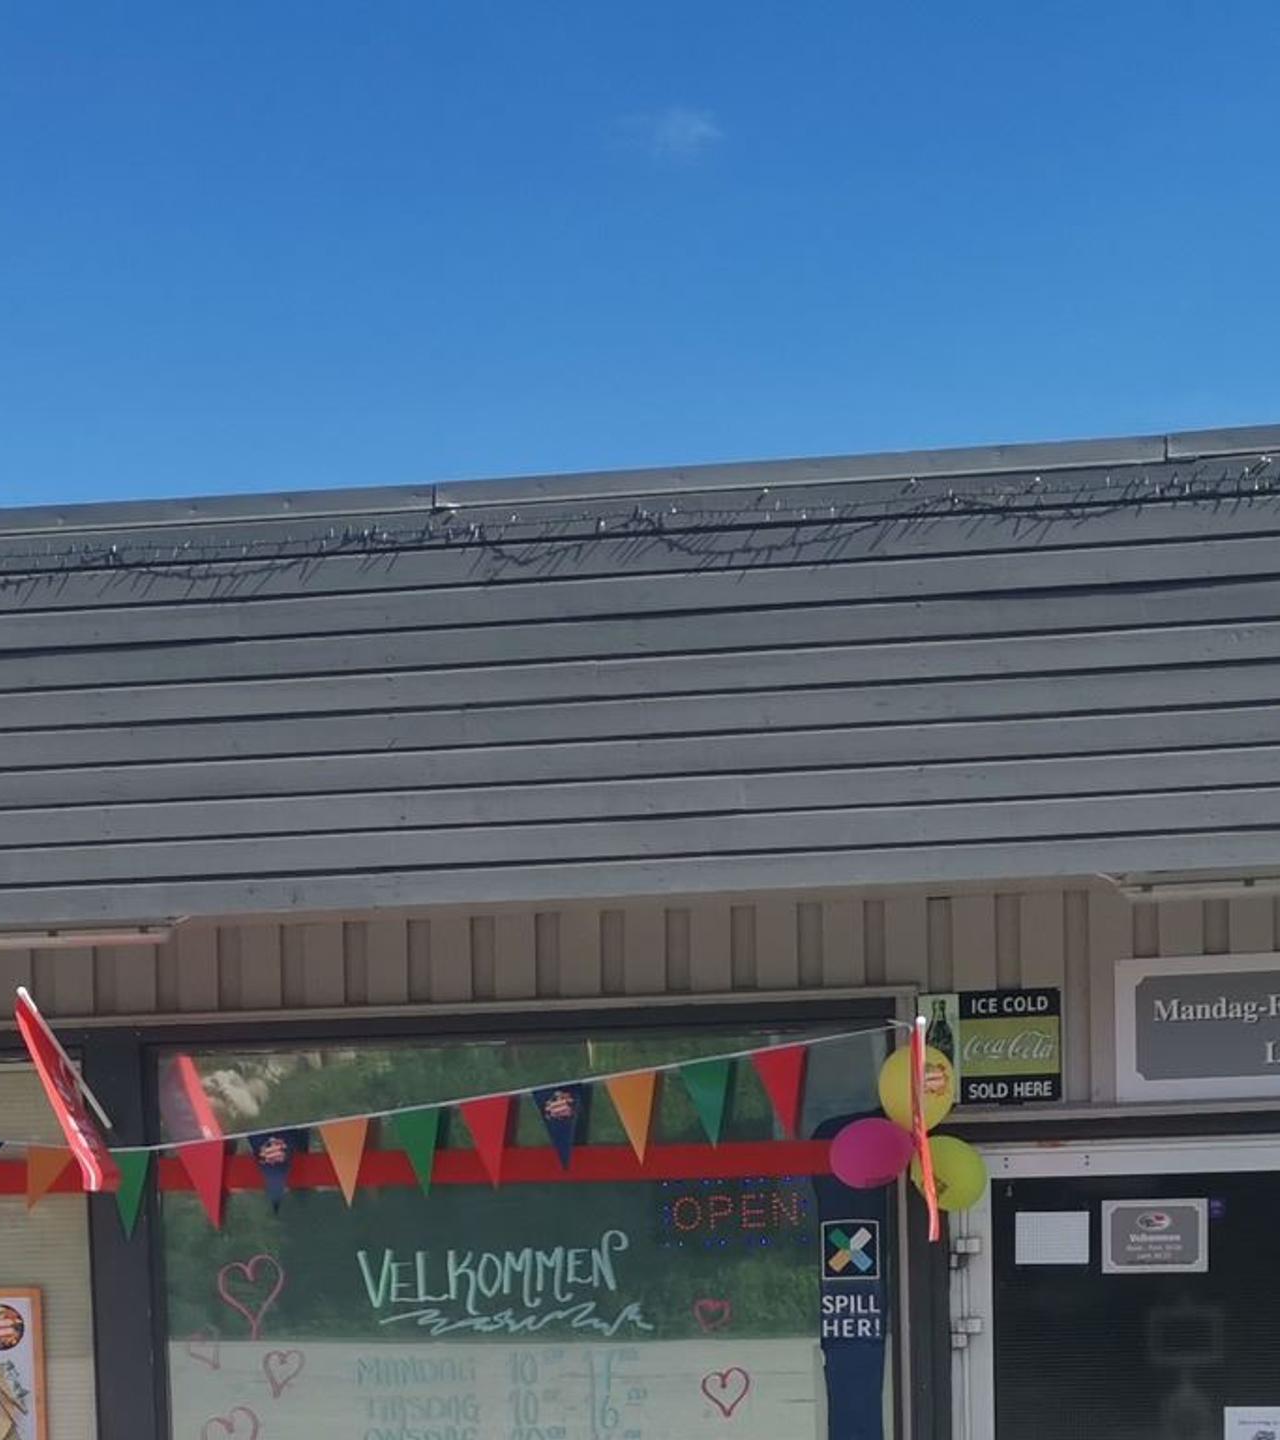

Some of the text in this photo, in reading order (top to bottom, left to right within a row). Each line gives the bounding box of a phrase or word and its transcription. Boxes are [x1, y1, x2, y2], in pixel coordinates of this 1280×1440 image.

[971, 996, 1048, 1014] ICE COLD
[968, 1081, 1053, 1099] SOLD HERE
[673, 1193, 800, 1231] OPEN
[357, 1230, 629, 1314] VELKOMMEN
[822, 1295, 880, 1314] SPILL
[823, 1319, 880, 1337] HER!
